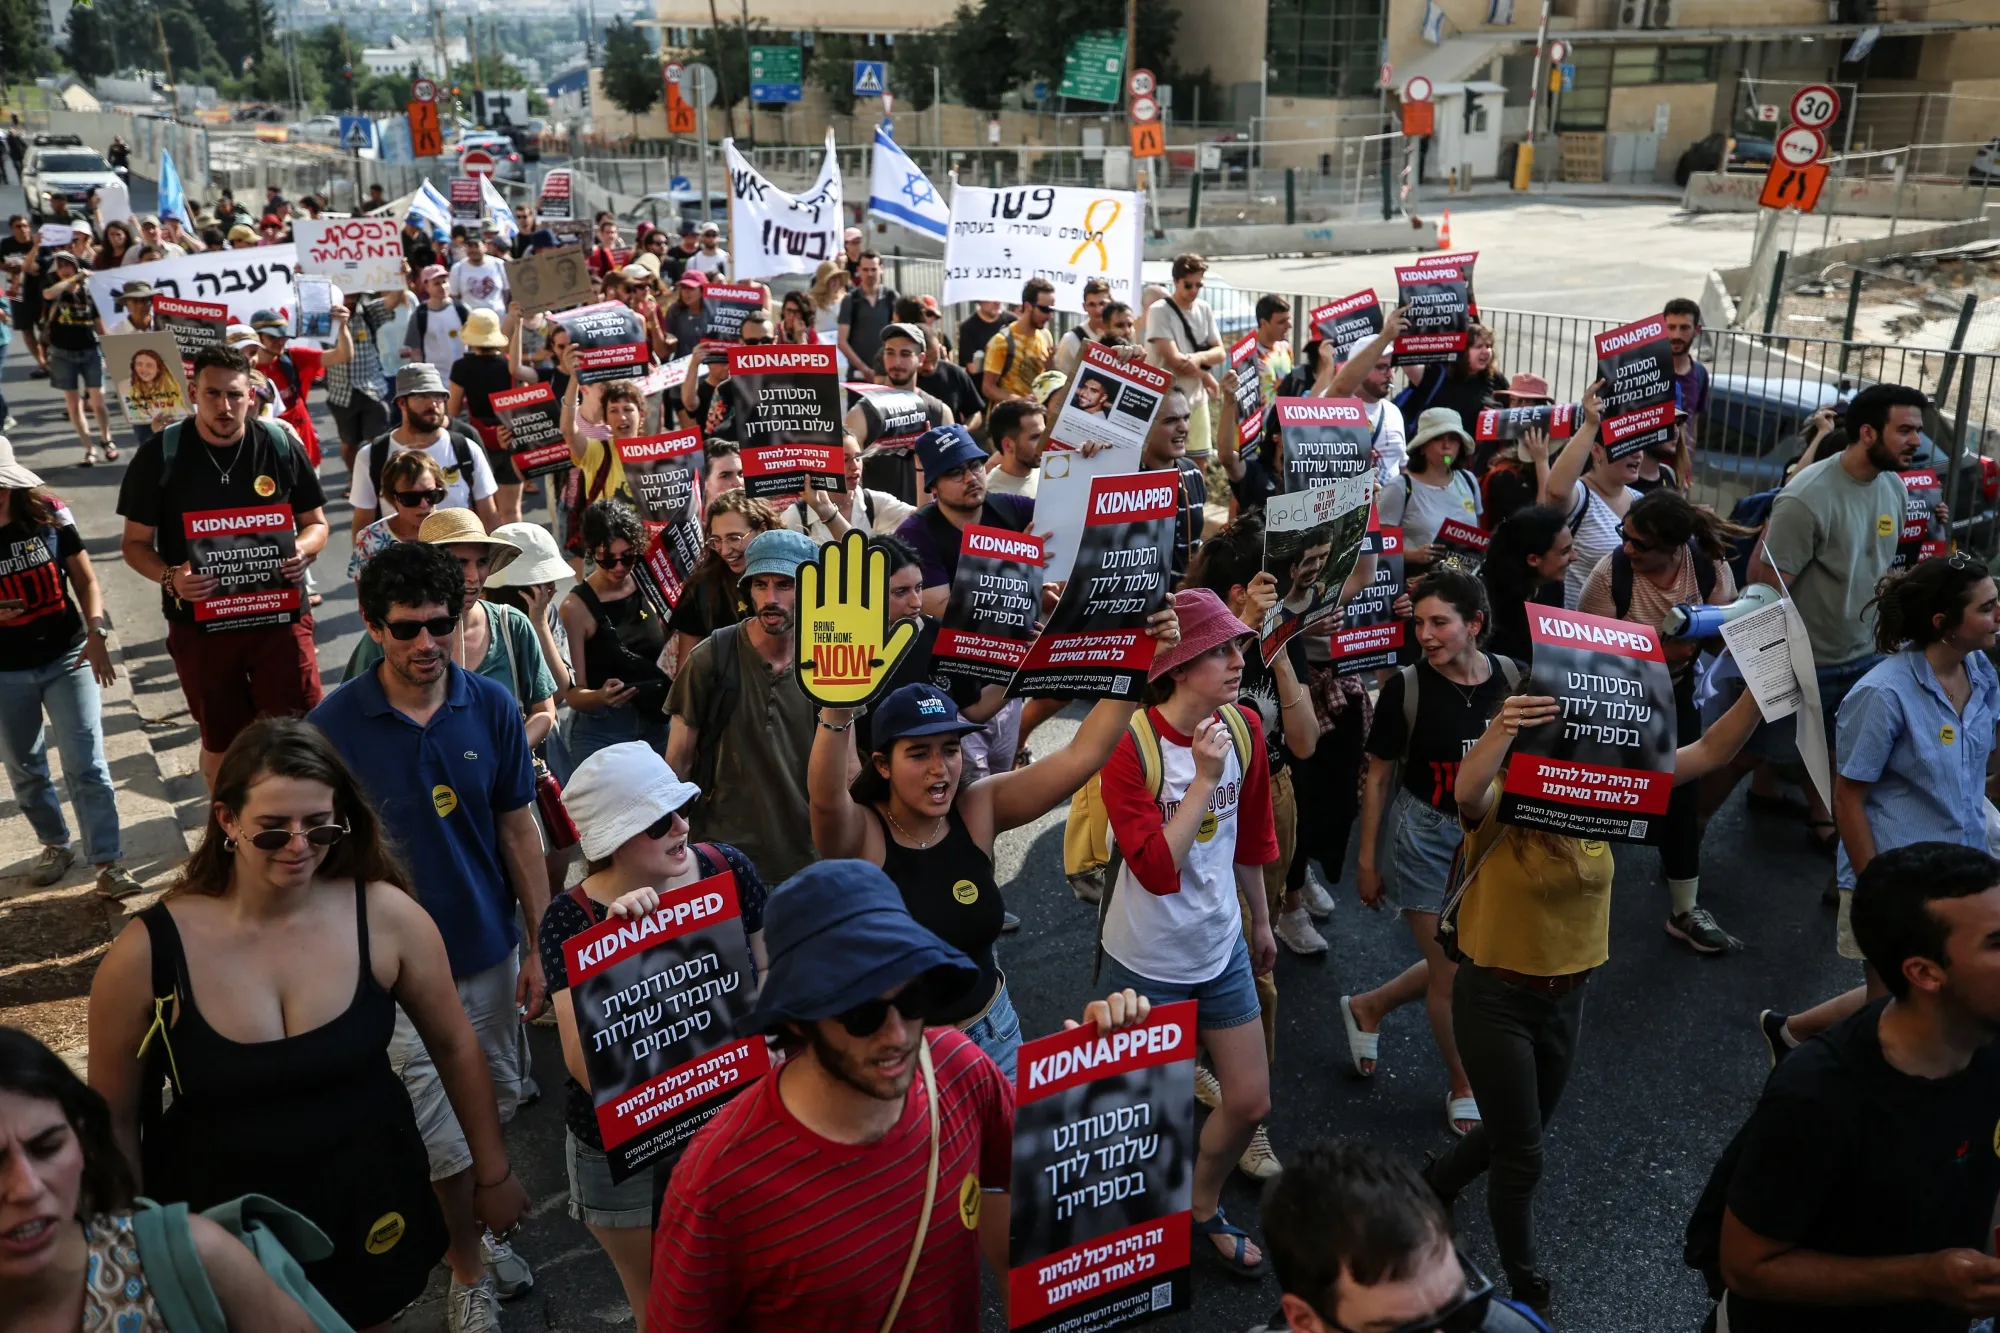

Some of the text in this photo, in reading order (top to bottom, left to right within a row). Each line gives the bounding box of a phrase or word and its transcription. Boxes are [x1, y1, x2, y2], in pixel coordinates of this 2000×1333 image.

[1800, 97, 1830, 120] 30
[317, 221, 397, 247] הפסקת
[310, 241, 401, 263] המלחמה
[975, 267, 1022, 280] במבצע
[1401, 269, 1457, 281] KIDNAPPED
[707, 288, 760, 300] KIDNAPPED
[159, 301, 222, 317] KIDNAPPED
[1316, 294, 1372, 319] KIDNAPPED
[1335, 317, 1370, 333] הסטודנט
[1601, 323, 1661, 353] KIDNAPPED
[737, 354, 829, 368] KIDNAPPED
[1089, 348, 1165, 387] KIDNAPPED
[1616, 356, 1656, 378] הסטודנט
[1624, 370, 1660, 391] שאמרת
[1646, 381, 1670, 397] שלום
[494, 389, 548, 407] KIDNAPPED
[758, 388, 816, 400] הסטודנט
[757, 402, 821, 416] שאמרת לו
[1284, 406, 1359, 420] KIDNAPPED
[746, 418, 834, 437] שלום במסדרון
[885, 412, 926, 431] שלום במסדרון
[622, 436, 696, 457] KIDNAPPED
[758, 448, 783, 460] להיות
[785, 448, 802, 456] יכול
[1298, 443, 1358, 455] הסטודנטית
[765, 459, 796, 469] מאיתנו
[1291, 458, 1365, 472] שתמיד שולחת
[641, 469, 689, 485] הסטודנט
[641, 486, 661, 500] לידך
[1095, 486, 1172, 515] KIDNAPPED
[1322, 499, 1336, 510] LEVY
[192, 513, 285, 532] KIDNAPPED
[1317, 511, 1328, 522] (33)
[1445, 525, 1490, 546] KIDNAP
[207, 546, 279, 562] הסטודנטית
[969, 534, 1039, 559] KIDNAPPED
[0, 556, 26, 575] הבית
[1102, 546, 1157, 569] הסטודנט
[221, 573, 270, 586] סיכומים
[980, 574, 1028, 592] הסטודנט
[1089, 569, 1159, 598] שלמד לידך
[972, 590, 1031, 610] שלמד לידך
[1365, 584, 1398, 597] שתמיד
[1084, 598, 1146, 615] בספרייה
[1348, 601, 1382, 616] סיכומים
[814, 621, 834, 631] BRING
[973, 608, 1024, 626] בספרייה
[814, 633, 852, 643] THEM HOME
[954, 635, 981, 645] להיות
[1050, 635, 1136, 649] זה להיות
[1539, 617, 1653, 653] KIDNAPPED
[813, 645, 875, 677] NOW
[956, 646, 987, 657] מאיתנו
[1048, 648, 1124, 662] כל אחד מאיתנו
[1568, 671, 1643, 698] הסטודנט
[1560, 696, 1651, 722] שלמד לידך
[1564, 722, 1640, 747] בספרייה
[1537, 764, 1649, 789] זה היה יכול להיות
[1542, 782, 1639, 805] כל אחד מאיתנו
[1517, 804, 1545, 814] חטופים
[1546, 810, 1568, 819] עסקת
[1596, 818, 1628, 827] סטודנטים
[577, 892, 725, 971] KIDNAPPED
[602, 952, 719, 1019] הסטודנטית
[593, 970, 740, 1053] שתמיד שולחת
[632, 1010, 711, 1061] סיכומים
[1029, 1022, 1182, 1089] KIDNAPPED
[616, 1045, 749, 1118] זו היתה יכולה להיות
[634, 1068, 739, 1126] כל אחת מאיתנו
[625, 1114, 700, 1159] דורשים חטופים
[1053, 1103, 1151, 1152] הסטודנט
[1045, 1133, 1159, 1196] שלמד לידך
[1057, 1171, 1146, 1220] בספרייה
[1038, 1228, 1164, 1285] זה היה יכול להיות
[1047, 1253, 1155, 1305] כל אחד מאיתנו
[1083, 1292, 1150, 1324] סטודנטים דורשים
